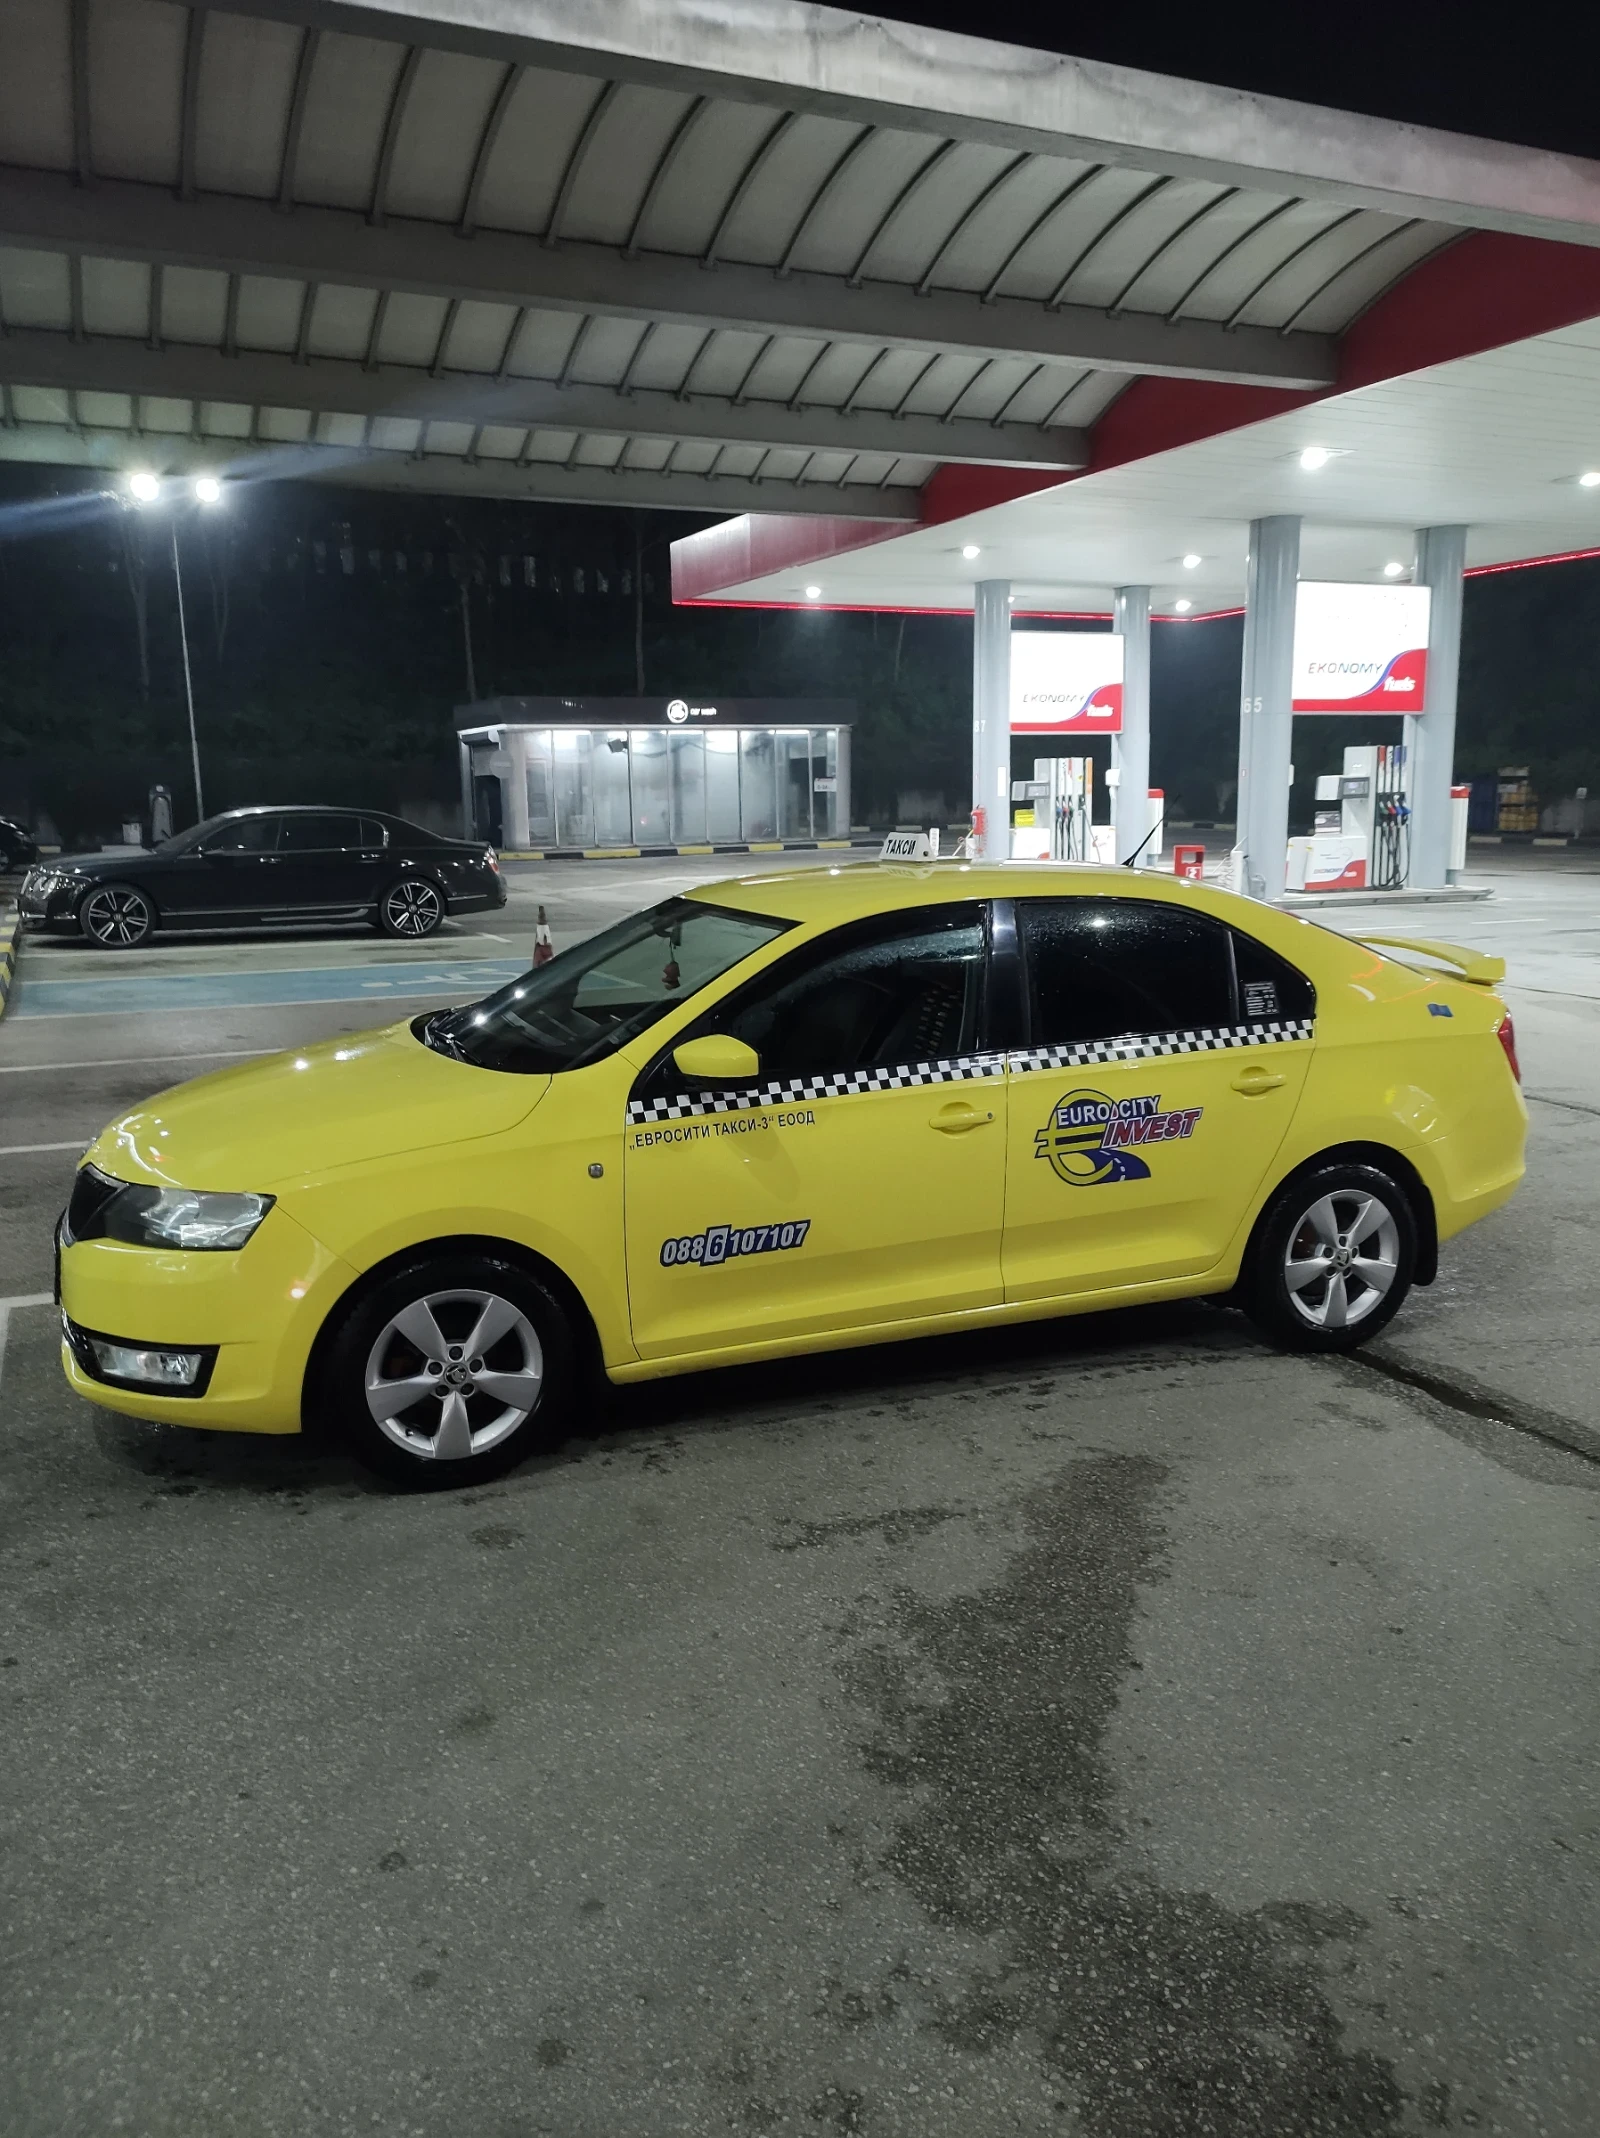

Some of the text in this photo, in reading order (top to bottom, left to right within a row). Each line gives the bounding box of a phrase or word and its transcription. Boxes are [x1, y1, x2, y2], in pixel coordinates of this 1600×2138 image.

[1308, 662, 1383, 674] EKONOMY
[1022, 693, 1085, 703] EKONOMY
[1243, 696, 1263, 713] 65
[885, 839, 917, 855] ТАКСИ
[778, 1110, 815, 1127] ЕООД
[1101, 1108, 1203, 1149] INVEST
[661, 1220, 810, 1266] 0886107107
